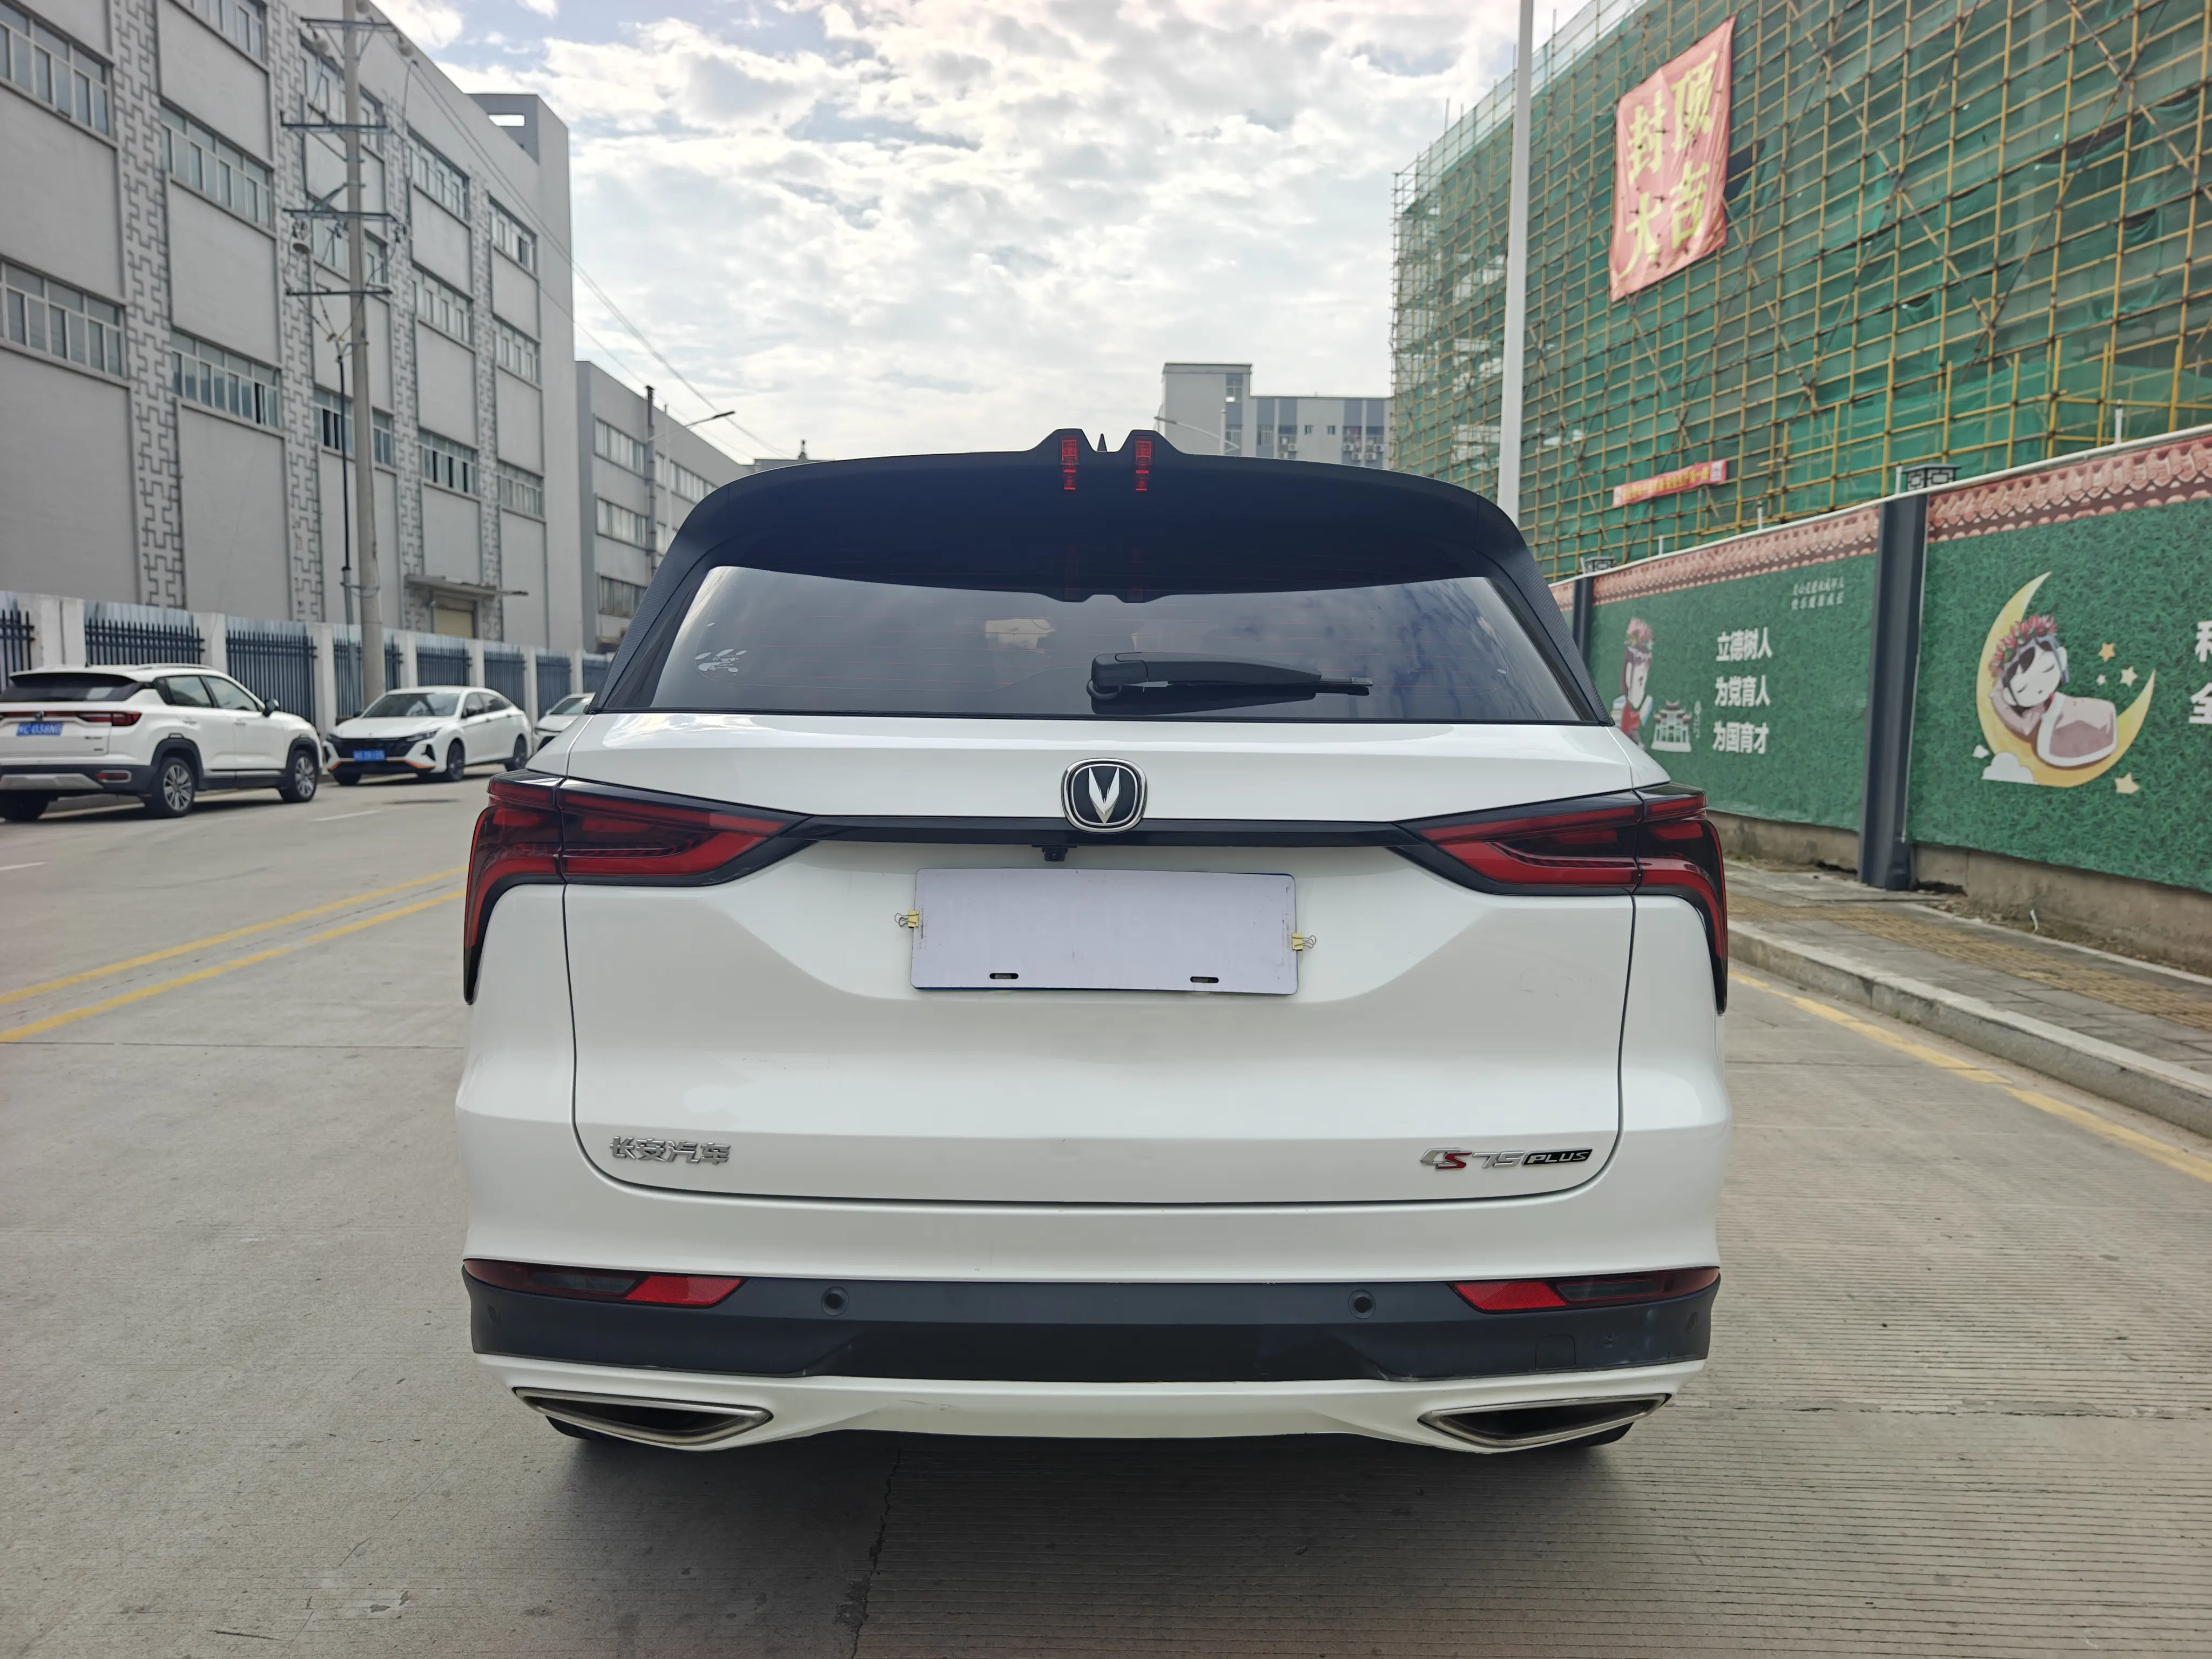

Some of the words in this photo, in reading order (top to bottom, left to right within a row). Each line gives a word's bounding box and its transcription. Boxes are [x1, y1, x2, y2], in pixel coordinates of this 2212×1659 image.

[1628, 50, 1718, 186] 封顶
[1618, 161, 1710, 279] 大吉
[1716, 627, 1773, 662] 立德树人
[1714, 675, 1771, 707] 为党育人
[1712, 721, 1770, 754] 为国育才
[610, 1136, 731, 1165] 长安汽车
[1420, 1148, 1525, 1170] CS75
[1525, 1150, 1591, 1165] PLUS
